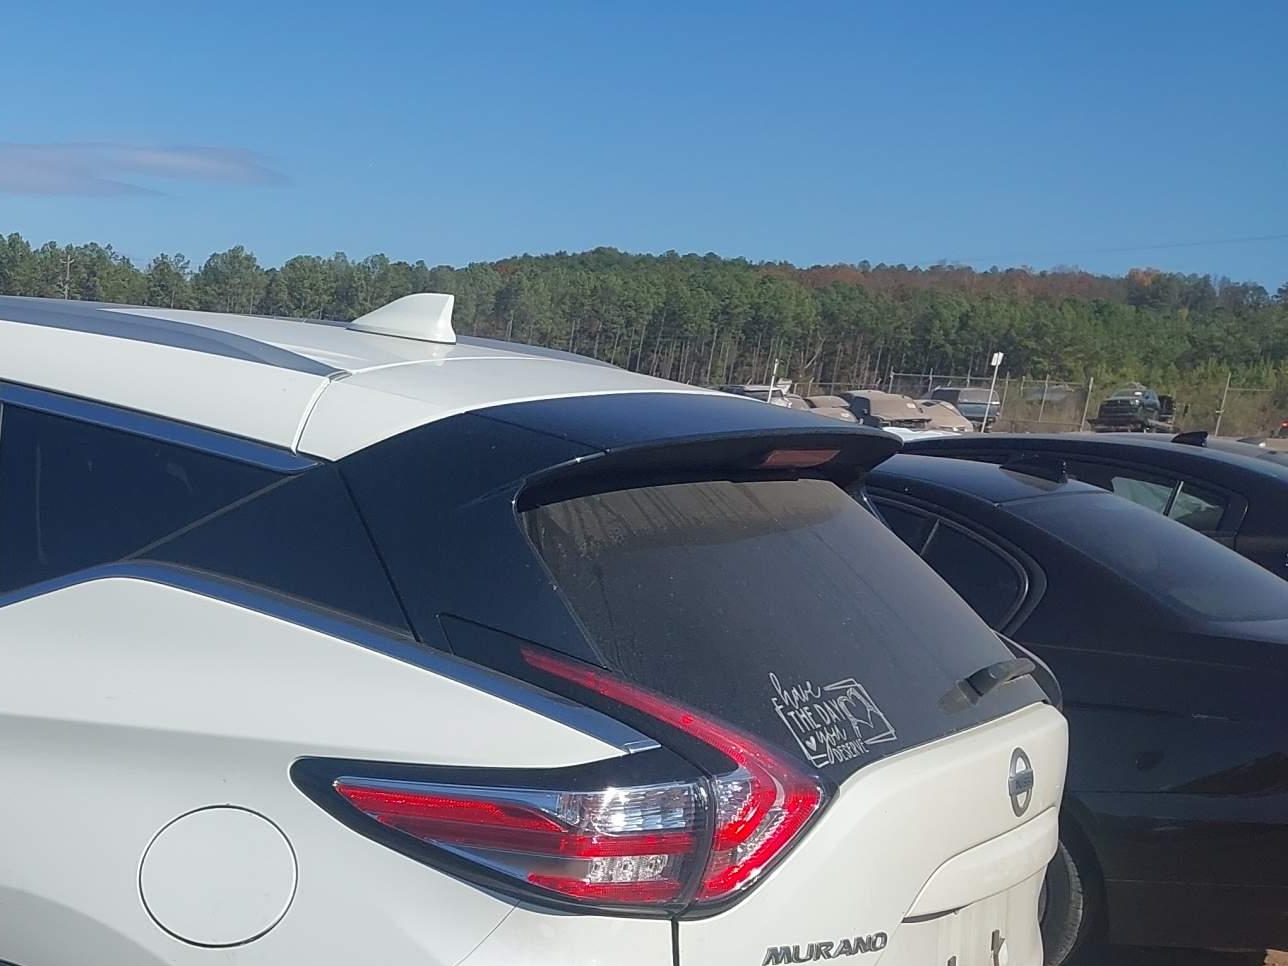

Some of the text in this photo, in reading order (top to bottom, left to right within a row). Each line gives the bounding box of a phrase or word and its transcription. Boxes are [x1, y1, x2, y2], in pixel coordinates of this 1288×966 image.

[769, 672, 821, 709] have
[787, 699, 847, 733] THE DAY
[815, 725, 847, 764] you
[832, 738, 869, 762] DESERVE
[762, 932, 888, 966] MURANO
